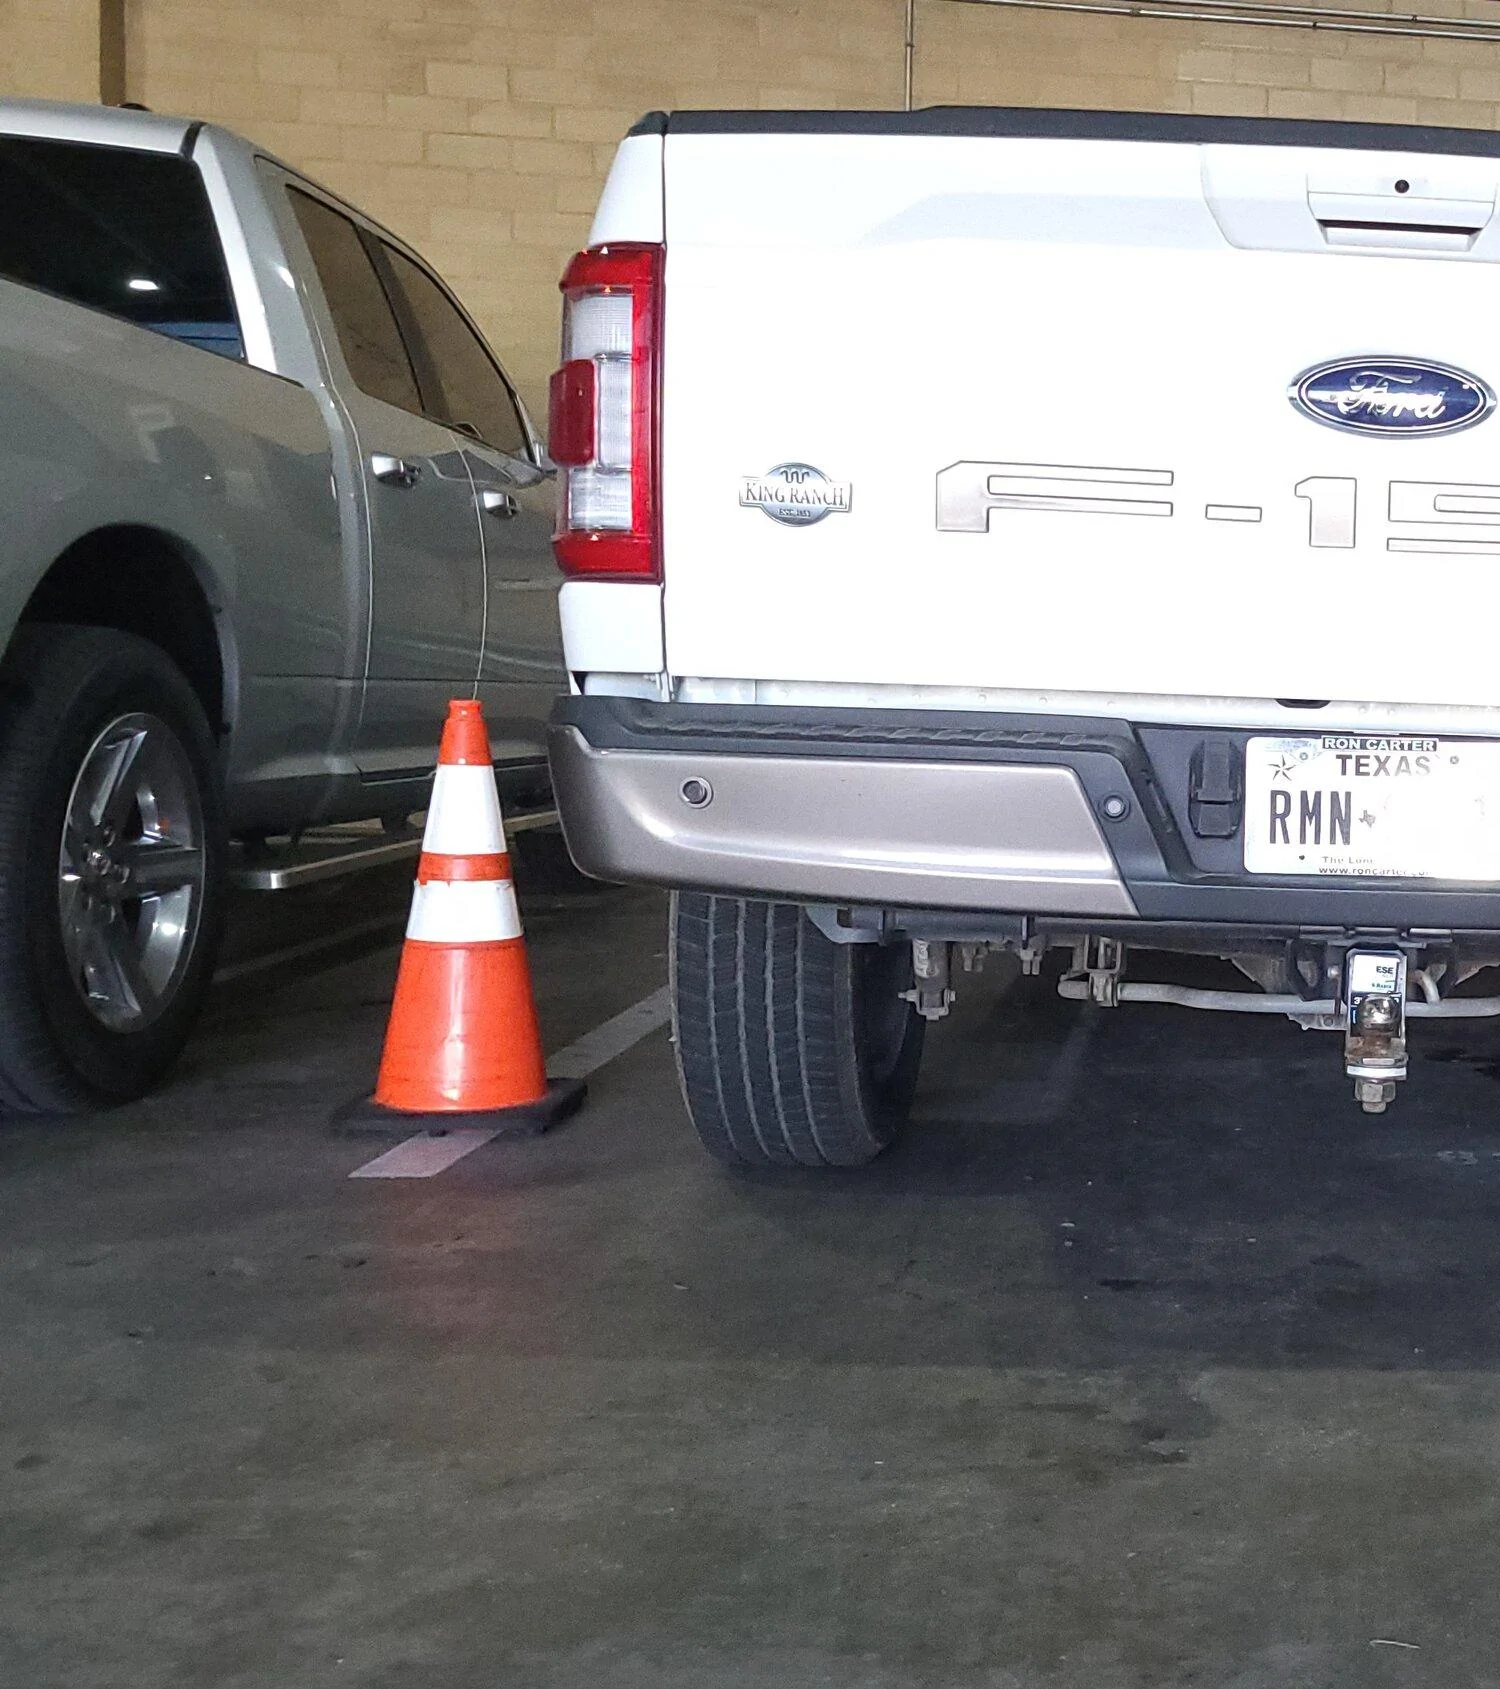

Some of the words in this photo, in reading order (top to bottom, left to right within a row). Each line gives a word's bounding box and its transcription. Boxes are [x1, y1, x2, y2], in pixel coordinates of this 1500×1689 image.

[1334, 370, 1447, 420] Ford
[745, 481, 786, 503] KING
[790, 485, 844, 506] RANCH
[1324, 738, 1361, 750] RON
[1365, 739, 1435, 752] CARTER
[1336, 753, 1432, 776] TEXAS
[1269, 789, 1352, 845] RMN
[1318, 867, 1433, 877] www.roncarter.co
[1349, 856, 1374, 865] Lon
